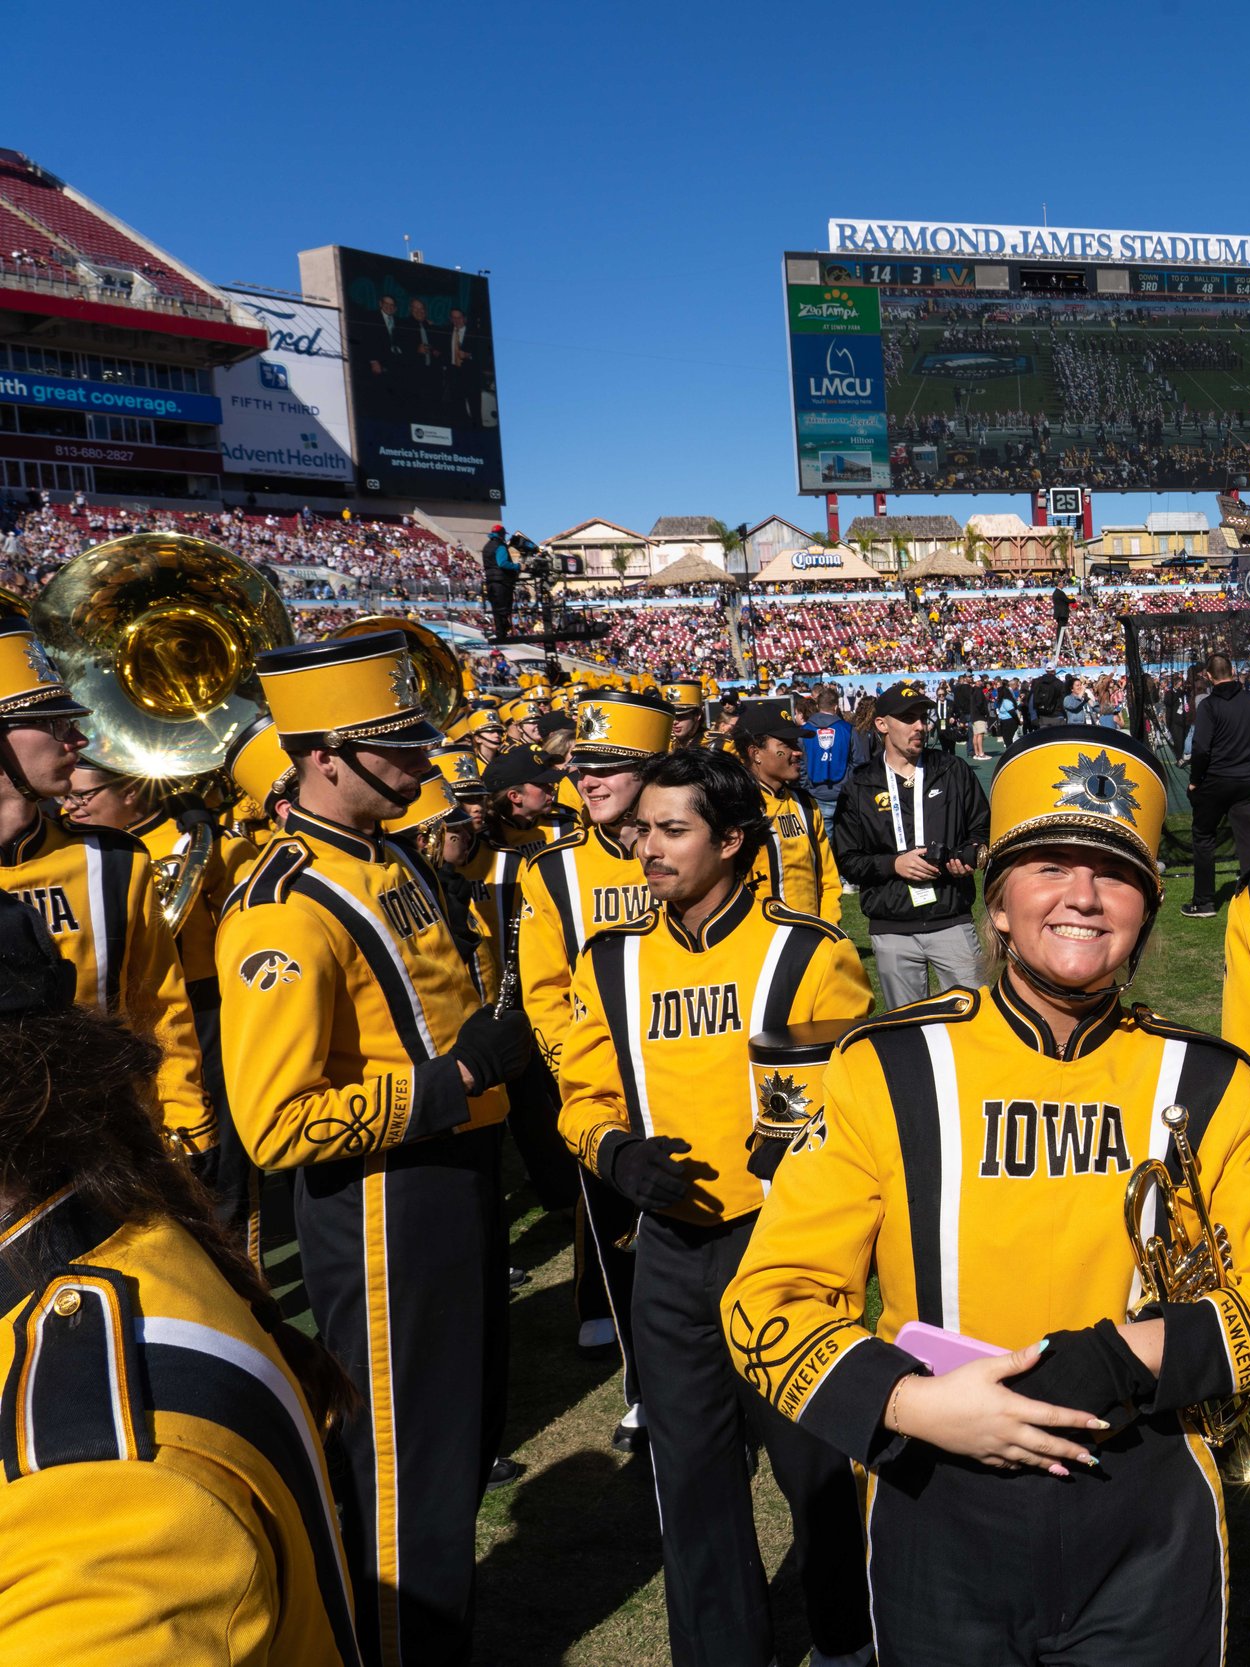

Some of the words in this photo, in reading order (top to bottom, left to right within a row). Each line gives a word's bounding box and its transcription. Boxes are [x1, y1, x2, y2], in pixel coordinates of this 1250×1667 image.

[836, 223, 1006, 252] RAYMOND
[1011, 230, 1113, 258] JAMES
[1120, 234, 1249, 264] STADIUM
[870, 265, 892, 284] 14
[912, 266, 922, 285] 3
[1140, 281, 1158, 292] 3RD
[1177, 282, 1184, 292] 4
[1202, 283, 1213, 293] 48
[0, 377, 28, 396] ith
[32, 384, 87, 402] great
[90, 390, 183, 415] coverage.
[810, 377, 872, 396] LMCU
[231, 395, 273, 411] FIFTH
[278, 401, 320, 416] THIRD
[850, 436, 874, 444] Hilton
[55, 445, 134, 461] 813-680-2827
[222, 442, 346, 470] AdventHealth
[379, 446, 419, 459] America's
[420, 450, 453, 461] Favorite
[453, 454, 484, 465] Beaches
[391, 459, 405, 467] are
[412, 460, 435, 470] short
[435, 463, 455, 471] drive
[455, 466, 476, 475] away
[1056, 494, 1076, 510] 25
[791, 551, 843, 570] Corona
[647, 982, 743, 1042] IOWA
[386, 1079, 408, 1144] HAWKEYES
[978, 1098, 1132, 1179] IOWA
